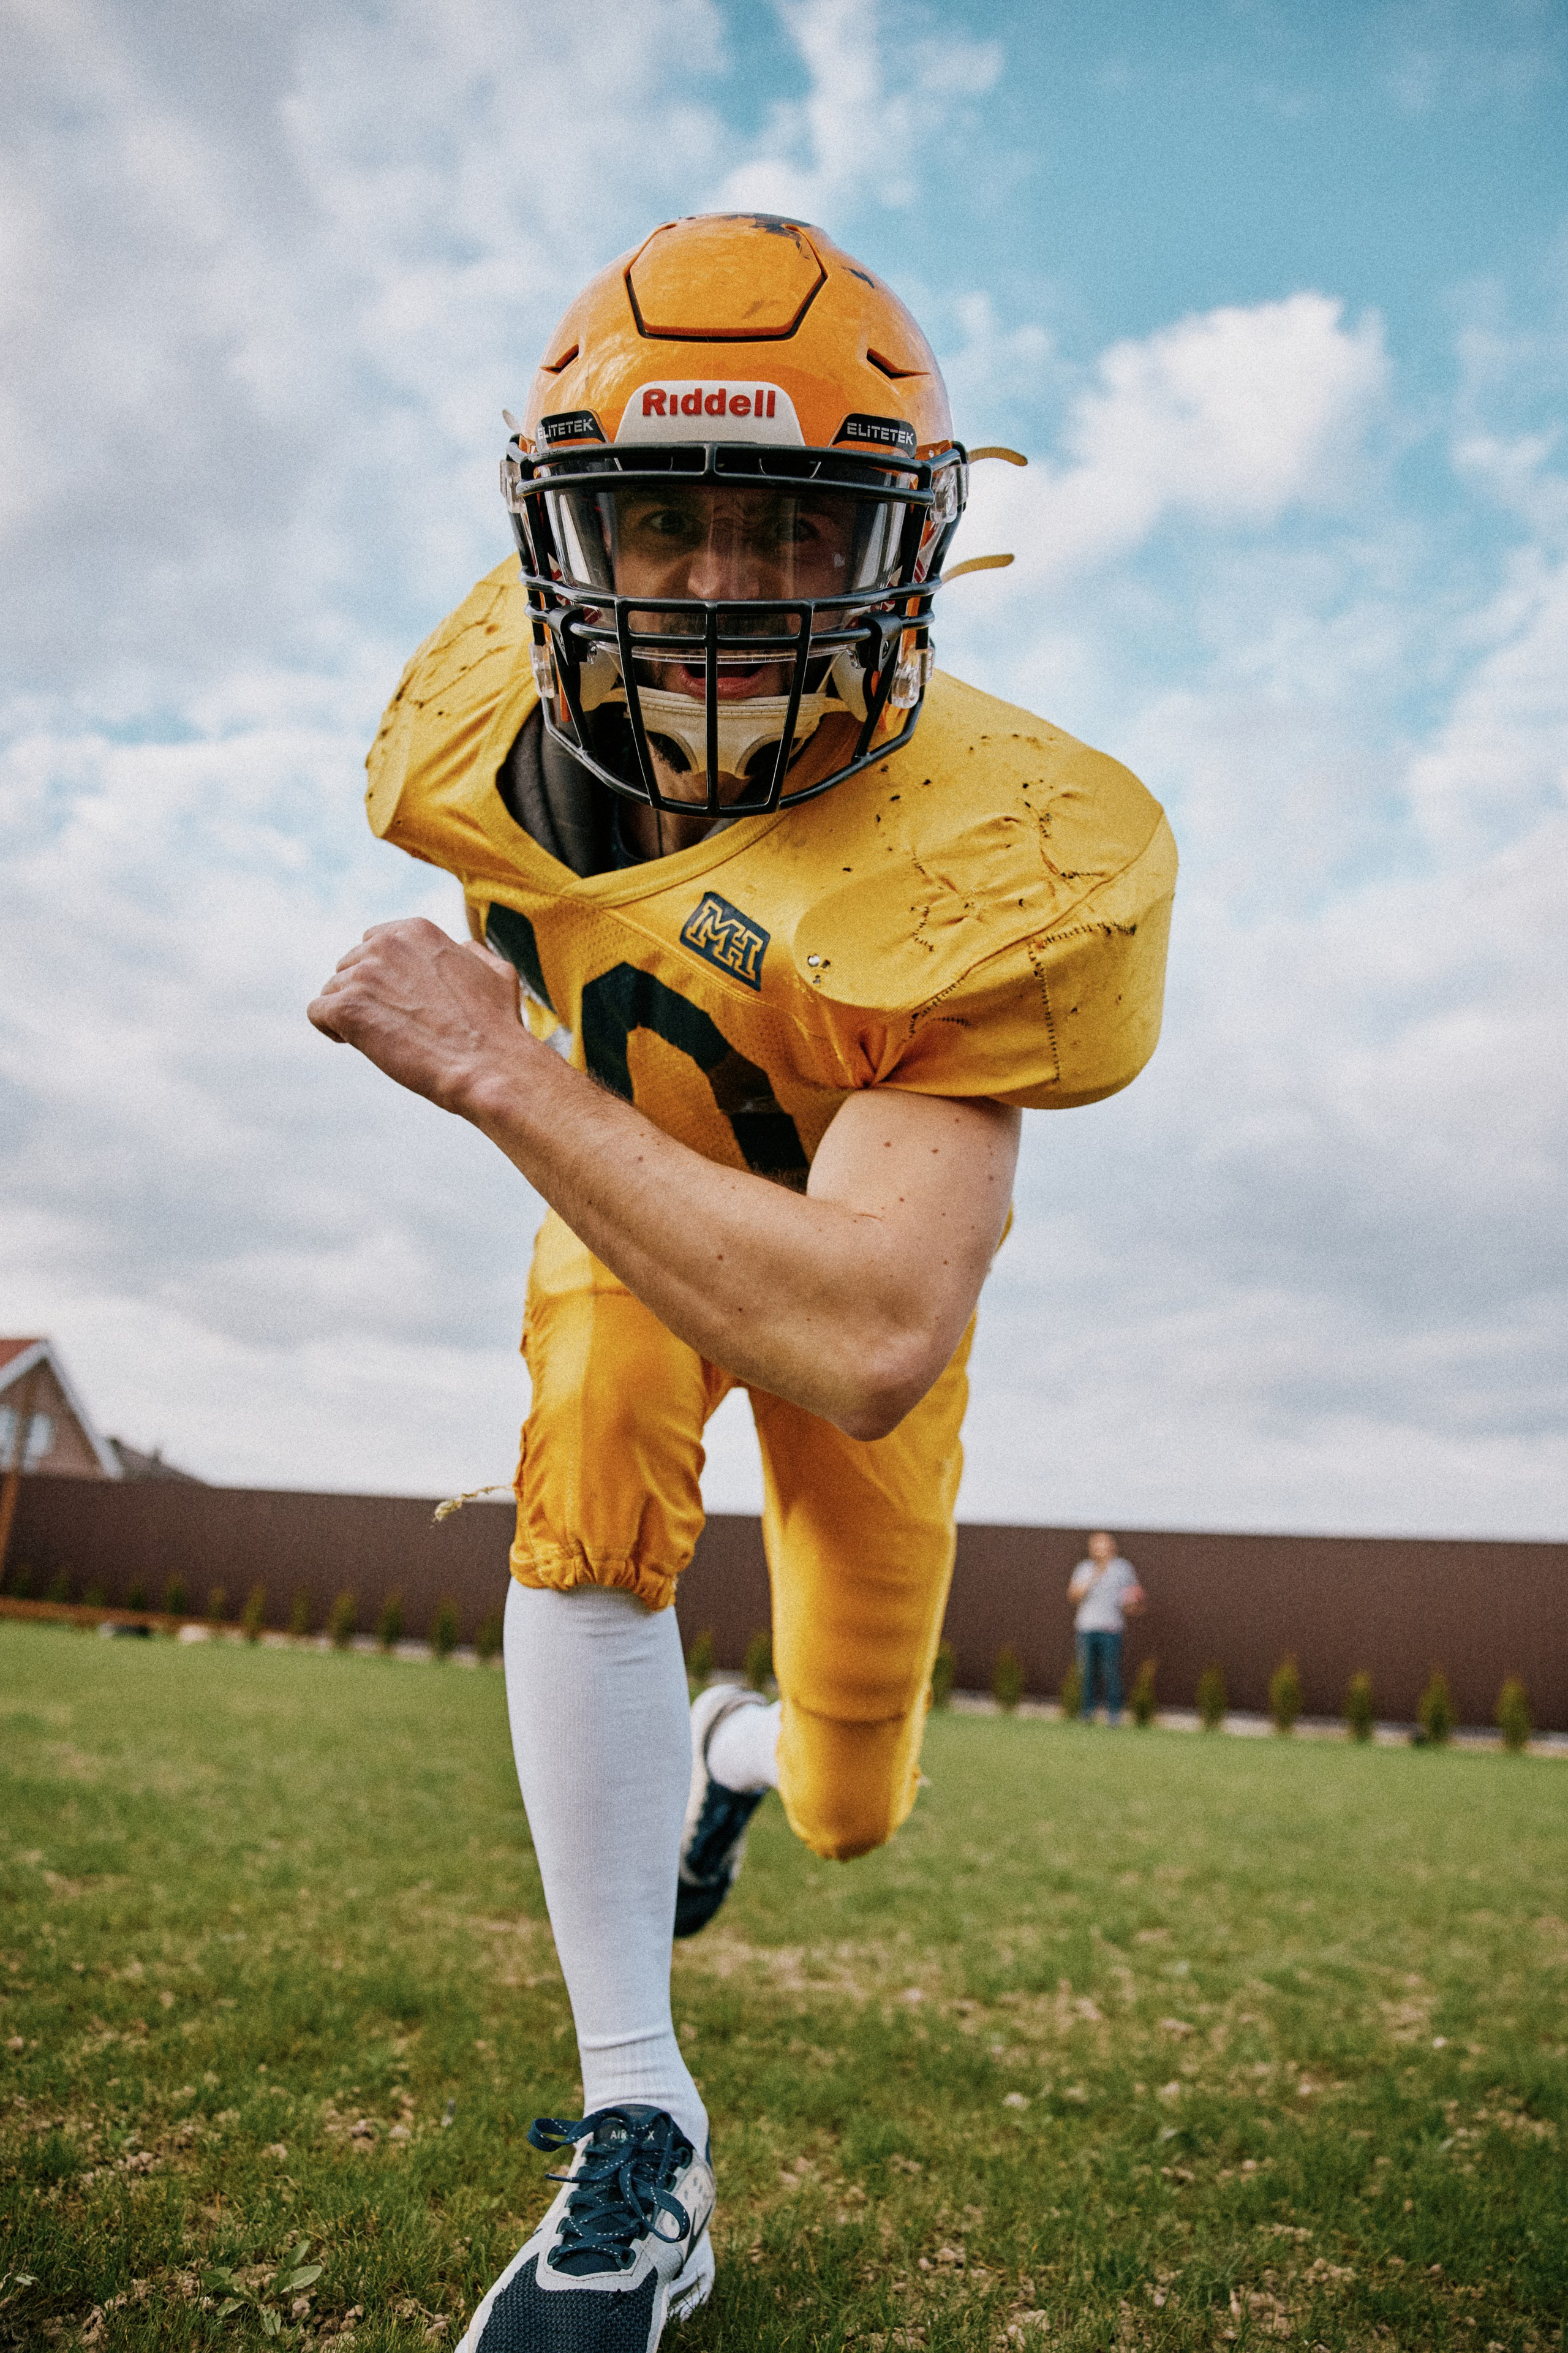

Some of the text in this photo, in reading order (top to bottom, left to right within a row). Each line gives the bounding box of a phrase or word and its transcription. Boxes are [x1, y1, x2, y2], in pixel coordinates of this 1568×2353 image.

[643, 388, 776, 417] Riddell
[537, 418, 594, 440] ELITETEK
[846, 422, 914, 445] ELITETEK
[685, 899, 763, 983] MH
